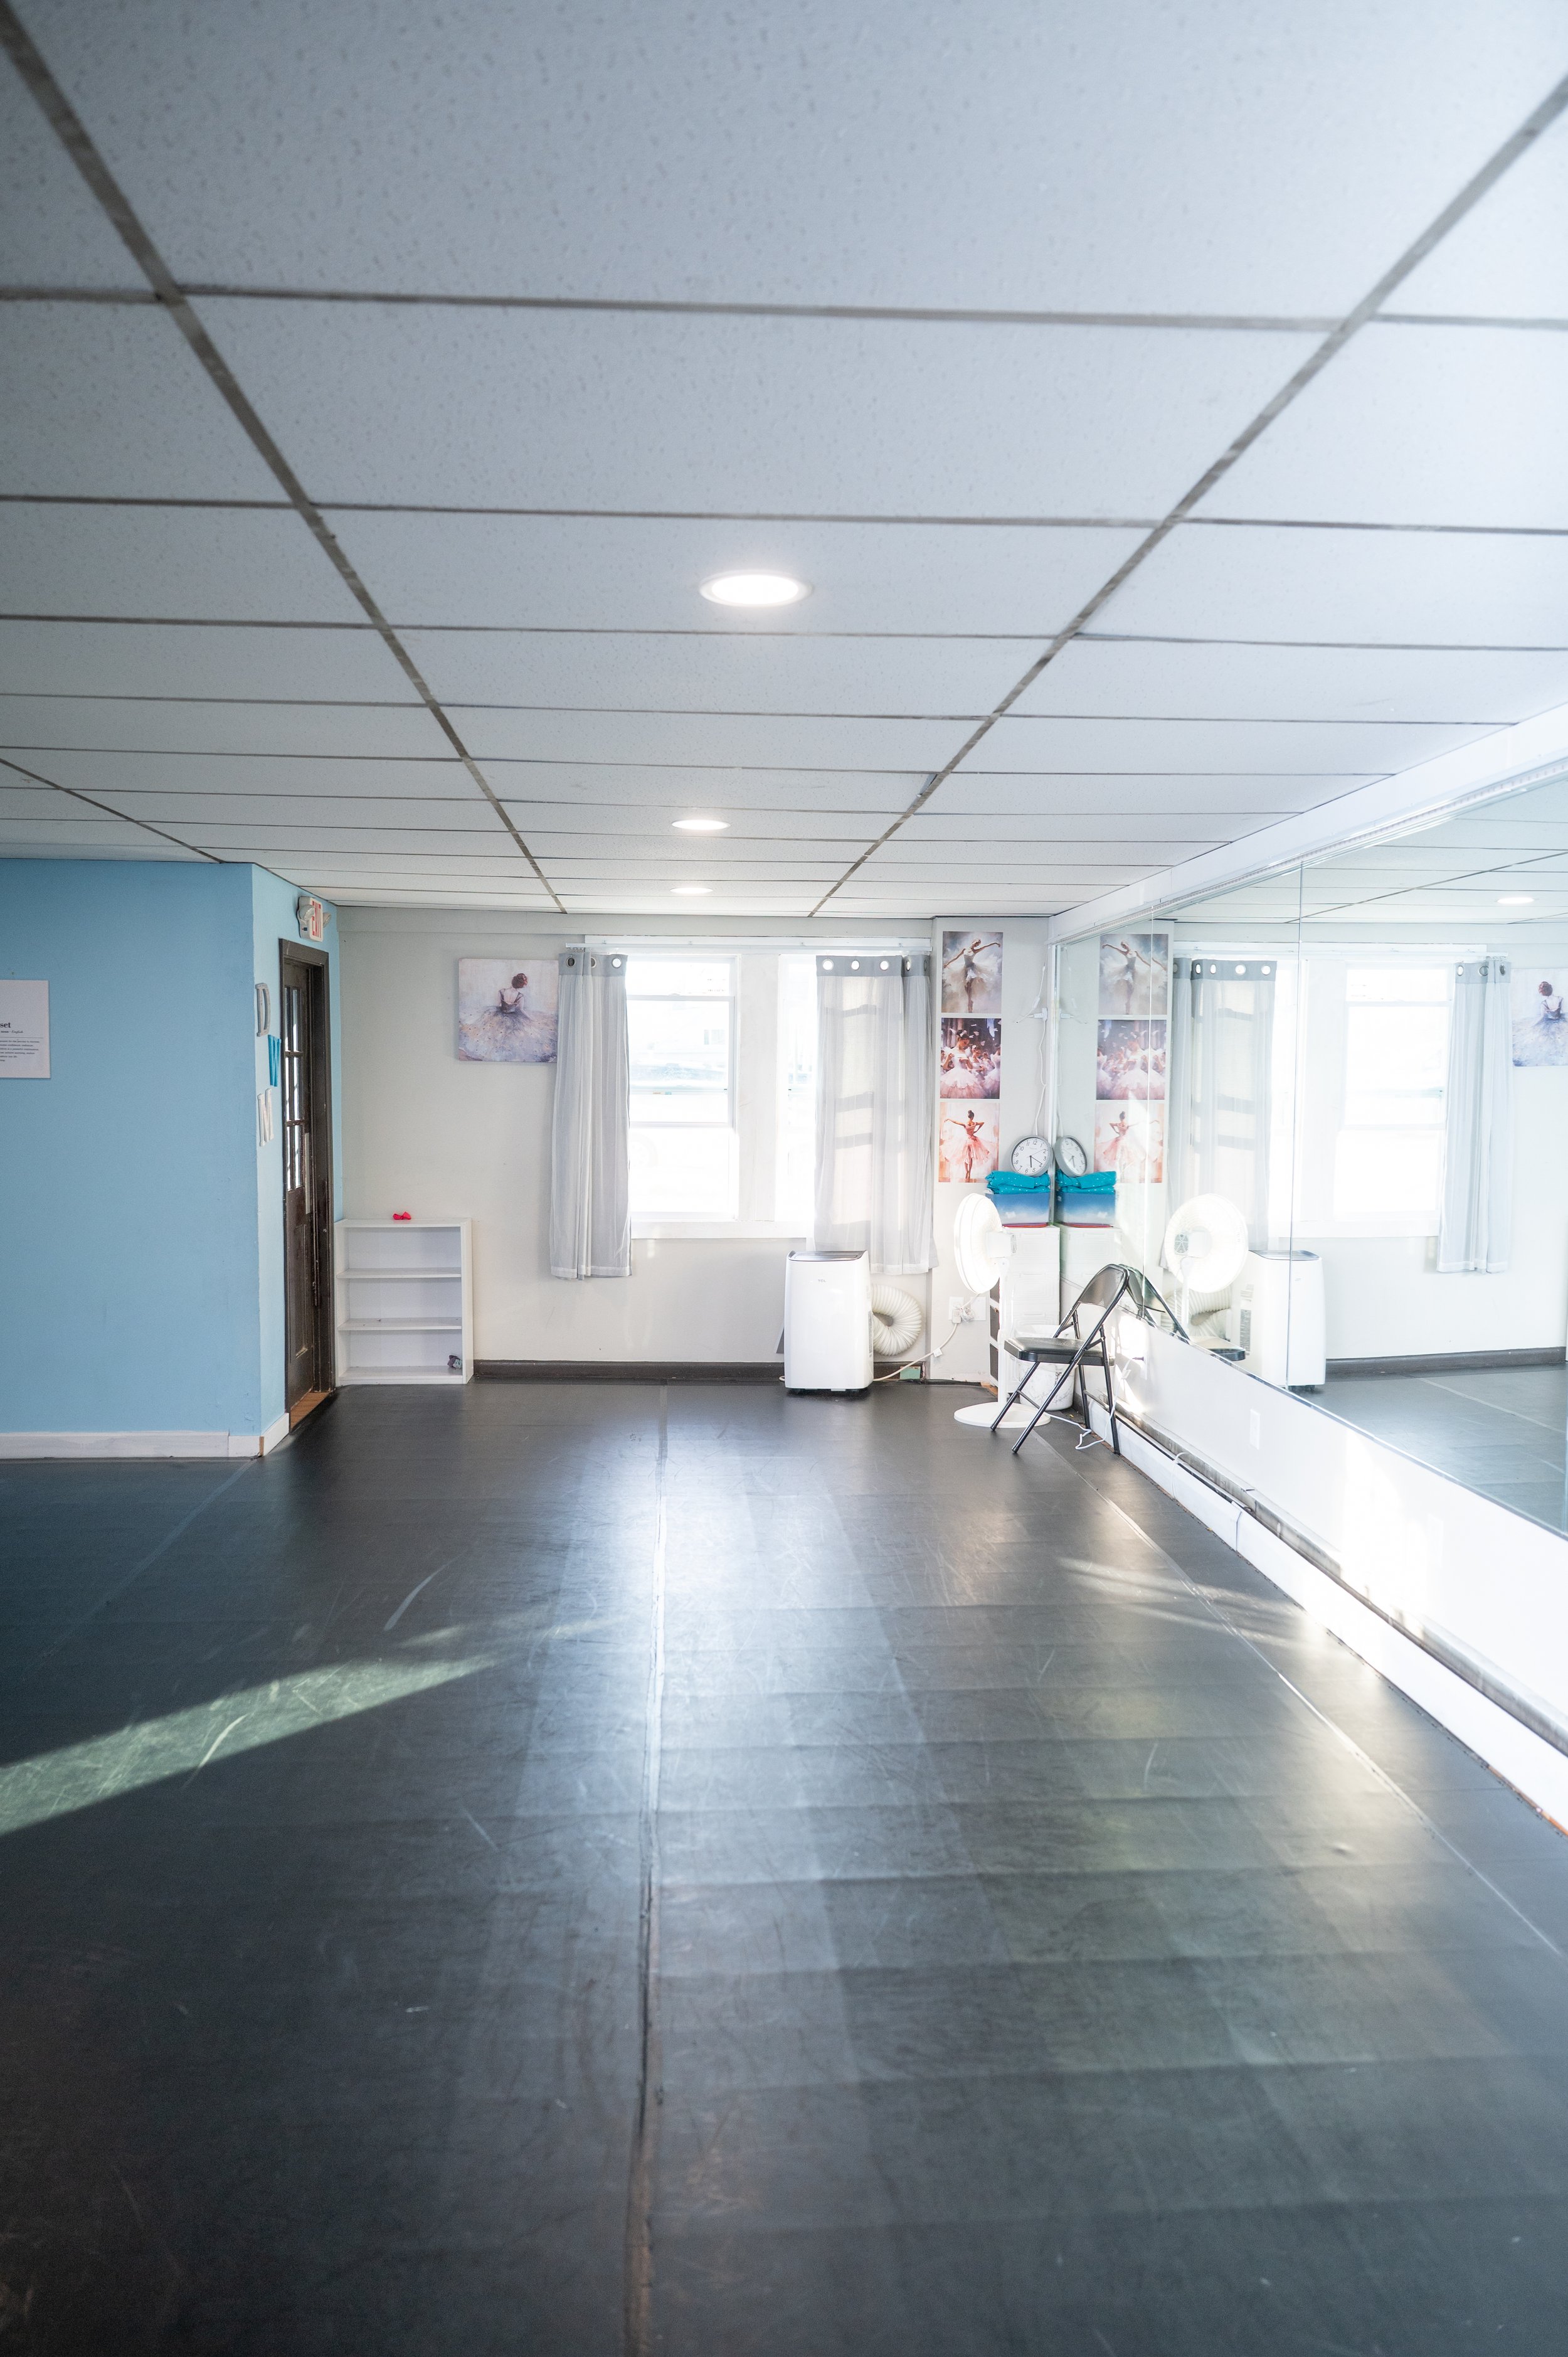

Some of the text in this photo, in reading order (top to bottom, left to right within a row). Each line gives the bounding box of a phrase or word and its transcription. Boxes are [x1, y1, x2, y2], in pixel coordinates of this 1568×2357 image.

[312, 900, 321, 938] EXIT
[255, 982, 271, 1037] D
[268, 1034, 282, 1087] W
